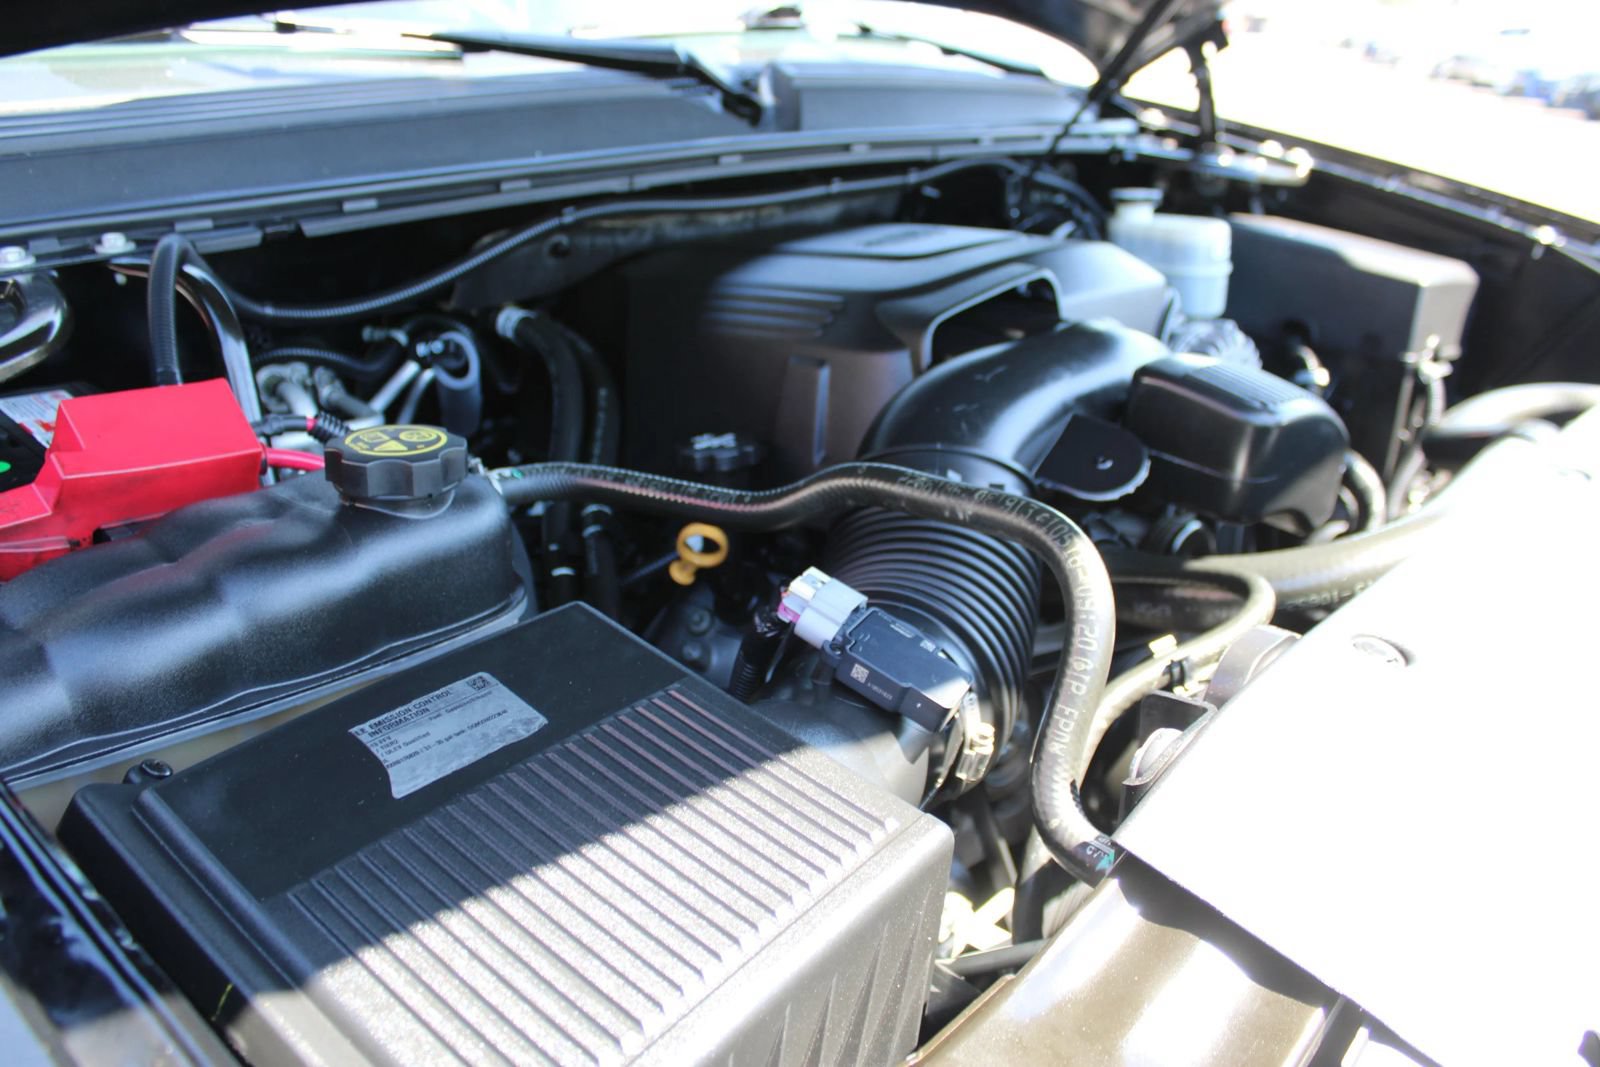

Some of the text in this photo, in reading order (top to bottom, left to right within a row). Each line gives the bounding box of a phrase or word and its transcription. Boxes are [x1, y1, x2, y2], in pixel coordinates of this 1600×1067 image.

[368, 708, 412, 729] EMISSION
[413, 689, 452, 710] CONTROL
[368, 707, 430, 738] INFORMATION
